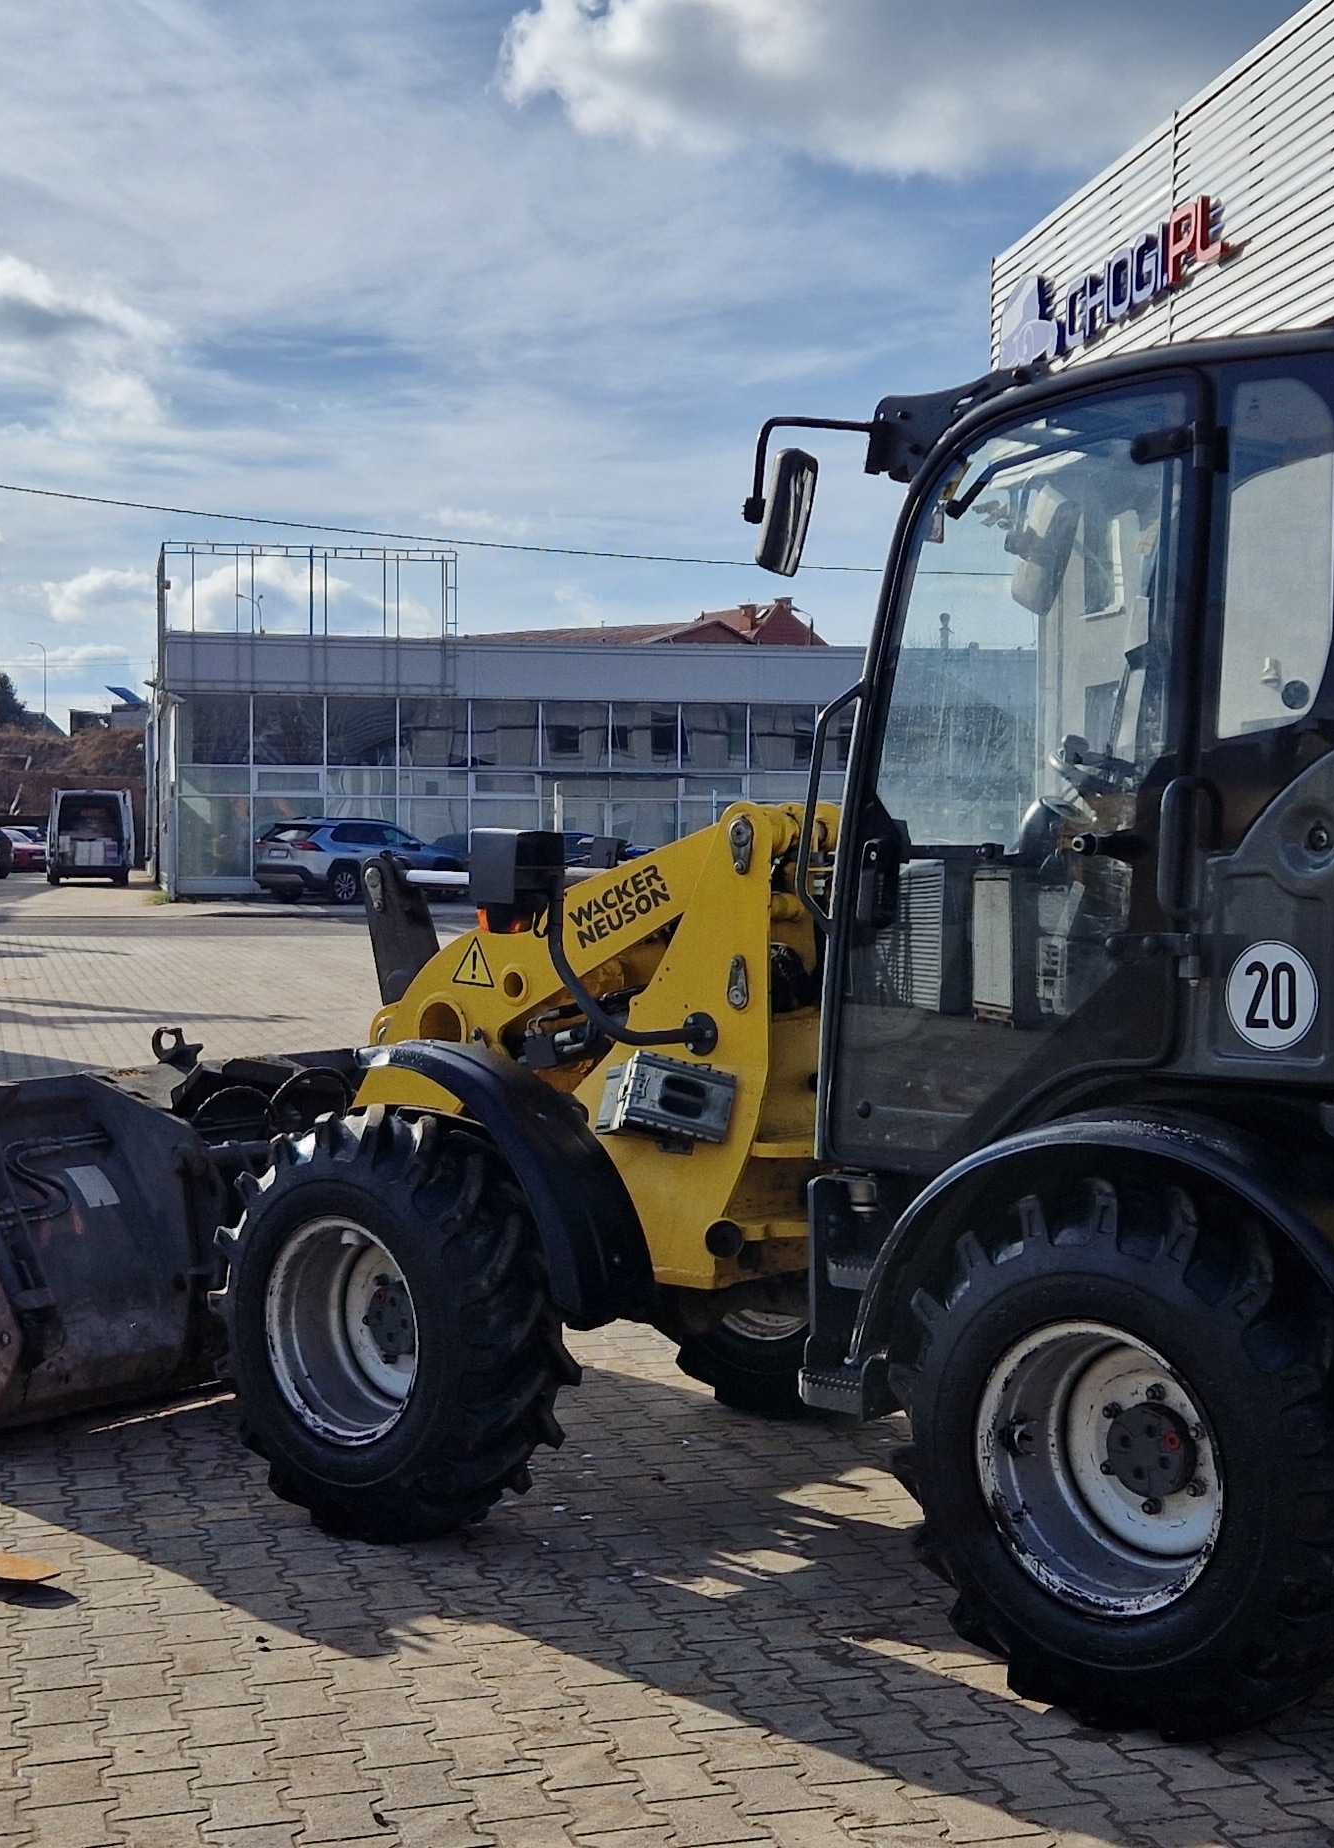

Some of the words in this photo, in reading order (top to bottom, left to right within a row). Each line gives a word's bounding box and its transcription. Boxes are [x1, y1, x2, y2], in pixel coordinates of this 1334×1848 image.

[1066, 195, 1227, 347] CHOGI.PL
[568, 865, 665, 927] WACKER
[577, 882, 670, 949] NEUSON
[1245, 961, 1296, 1030] 20
